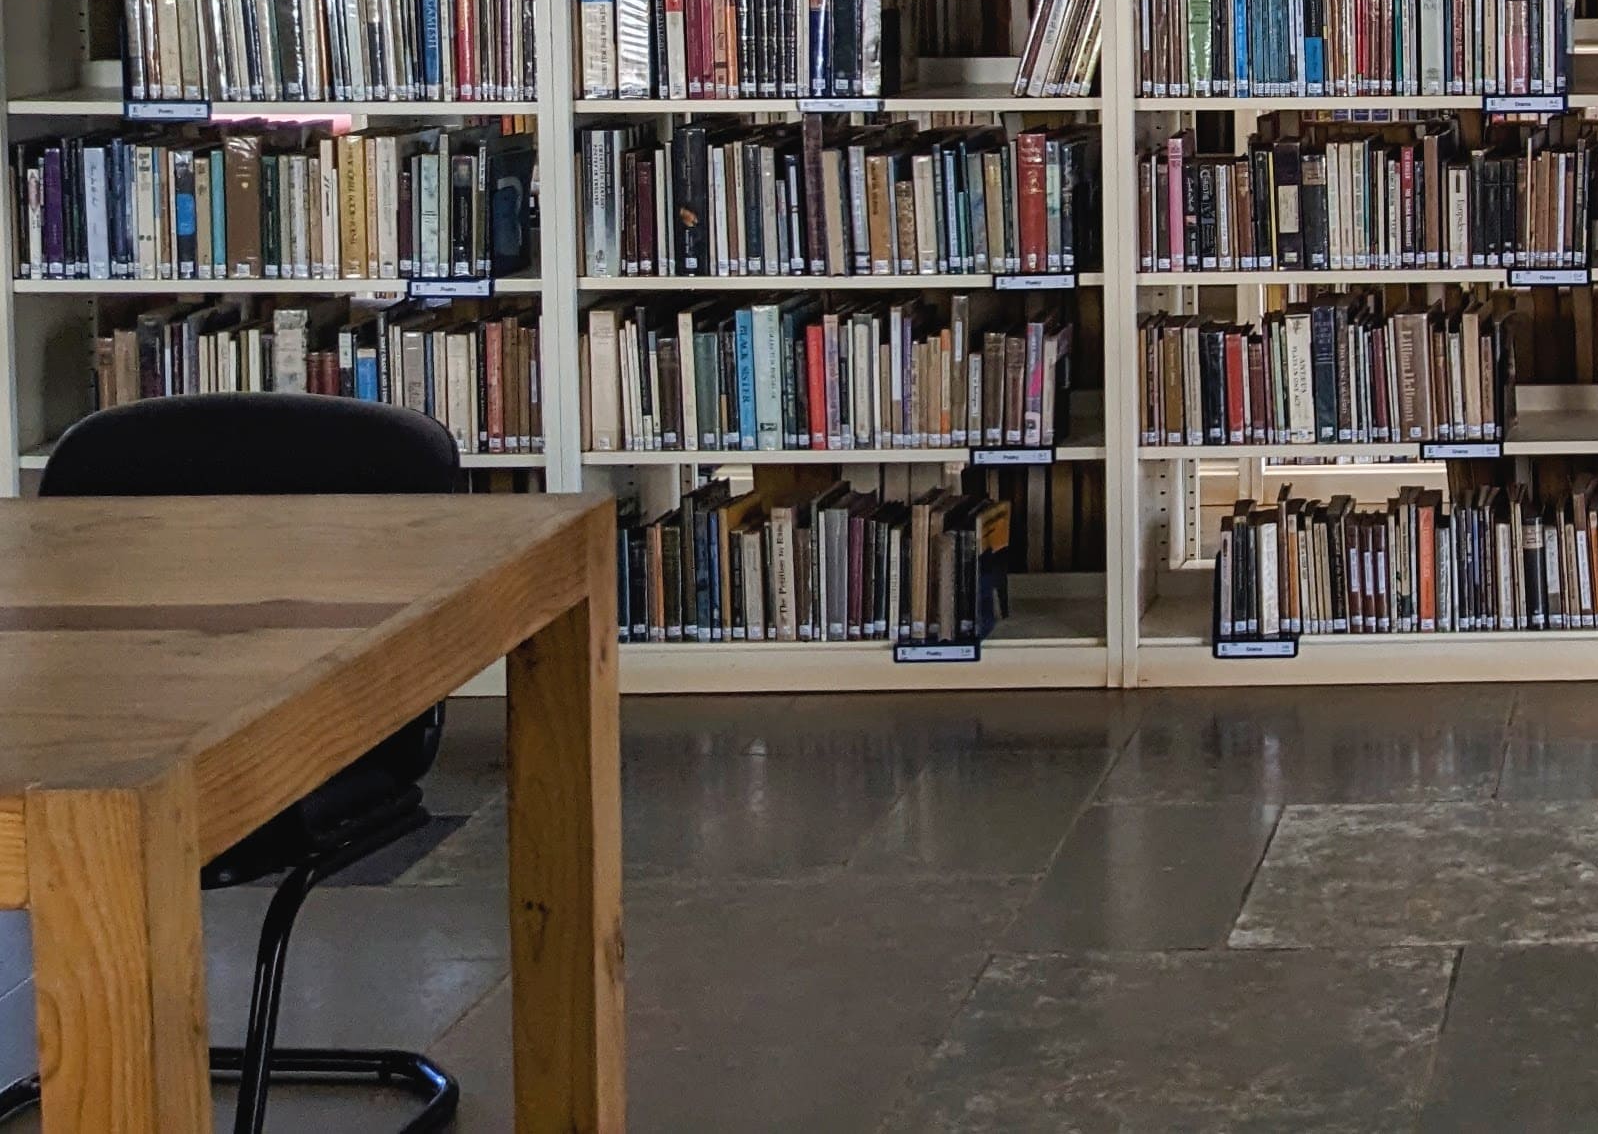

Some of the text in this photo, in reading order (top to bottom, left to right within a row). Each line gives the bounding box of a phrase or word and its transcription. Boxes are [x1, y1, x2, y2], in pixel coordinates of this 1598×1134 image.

[1456, 199, 1465, 232] Euripides
[740, 325, 751, 403] BLACK SISTER
[1402, 372, 1416, 422] Hellman
[779, 598, 787, 614] The
